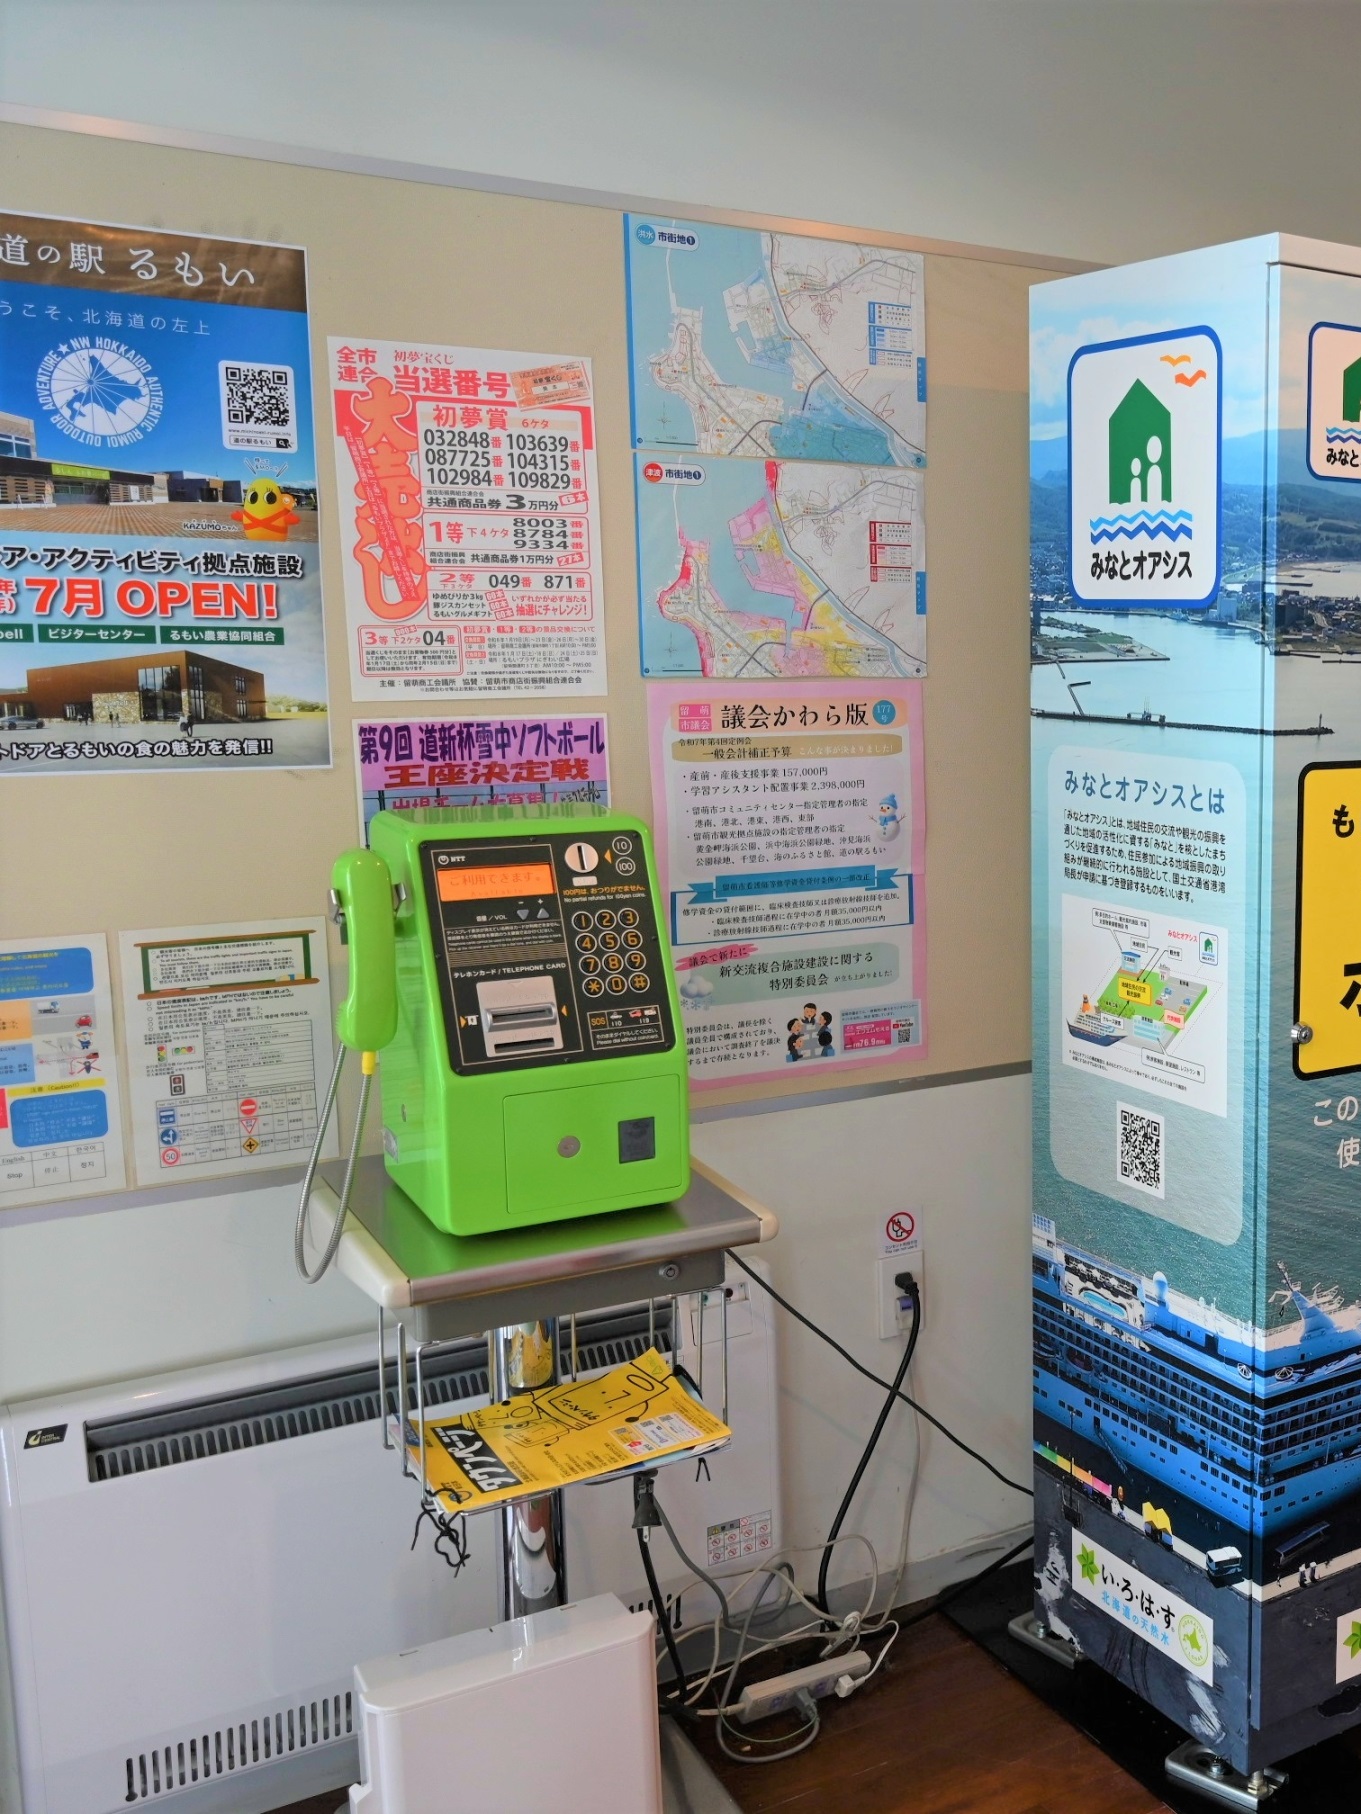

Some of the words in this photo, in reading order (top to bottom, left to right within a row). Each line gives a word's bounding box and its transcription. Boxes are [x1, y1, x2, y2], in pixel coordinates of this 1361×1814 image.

[129, 248, 254, 287] るもい
[70, 336, 90, 349] NW
[95, 337, 151, 375] HOKKAIDO
[394, 350, 454, 365] 初夢宝くじ
[37, 351, 61, 411] ADVENTURE
[394, 365, 510, 399] 当選番号
[145, 376, 163, 432] AUTHENTIC
[433, 405, 508, 430] 初夢賞
[52, 416, 101, 447] OUTDOOR
[107, 429, 144, 448] RUMOI
[424, 429, 502, 449] 032848番
[506, 434, 580, 452] 103639番
[425, 449, 503, 468] 087725番
[508, 453, 581, 471] 104315番
[427, 468, 504, 487] 102984番
[508, 472, 582, 490] 109829番
[429, 522, 463, 543] 1等
[513, 518, 583, 528] 8003番
[513, 528, 583, 539] 8784番
[514, 539, 583, 550] 9334番
[471, 553, 554, 565] 共通商品券1万円分
[1090, 550, 1193, 582] みなとオアシス
[439, 573, 475, 583] 2等
[489, 574, 532, 589] 049番
[544, 575, 586, 589] 871番
[25, 577, 103, 616] 7月
[117, 581, 278, 619] OPEN!
[512, 595, 587, 603] いずれかが必ず当たる
[516, 604, 587, 616] 抽選にチャレンジ!
[49, 628, 145, 640] ビジターセンター
[170, 630, 275, 642] るもい農業協同組合
[365, 632, 388, 645] 3等
[423, 631, 455, 645] 04番
[721, 704, 868, 729] 議会かわら版
[877, 706, 891, 714] 177
[680, 719, 711, 731] 市議会
[359, 725, 413, 764] 第9回
[419, 722, 605, 762] 道新杯雪中ソフトボール
[679, 737, 751, 746] 令和7年第4回定例会
[703, 747, 792, 760] 一般会計補正予算
[384, 758, 590, 789] 王座決定戦
[782, 767, 828, 778] 157,000円
[811, 780, 865, 791] 2,398,000円
[1064, 770, 1224, 814] みなとオアシスとは
[1063, 809, 1226, 844] 「みなとオアシス」とは、地域住民の交流や観光の振興を
[616, 842, 627, 850] 10
[1063, 839, 1226, 876] づくりを促進するため、住民参加による地域振興の取り
[619, 863, 632, 871] 100
[580, 915, 585, 927] 1
[602, 913, 611, 925] 2
[626, 912, 633, 924] 3
[606, 934, 614, 946] 5
[628, 933, 636, 945] 6
[1167, 930, 1198, 942] みなとオアシス
[582, 937, 591, 949] 4
[609, 957, 619, 969] 8
[631, 954, 640, 966] 9
[689, 948, 748, 967] 議会で新たに
[586, 959, 595, 971] 7
[720, 951, 873, 978] 新交流複合施設建設に関する
[454, 969, 497, 978] テレホンカード
[502, 965, 543, 974] TELEPHONE
[612, 978, 621, 990] 0
[769, 973, 829, 991] 特別委員会
[591, 1017, 606, 1025] SOS
[164, 1153, 176, 1161] 50
[434, 1427, 516, 1492] タウンページ
[1101, 1591, 1170, 1646] 北海道の天然水
